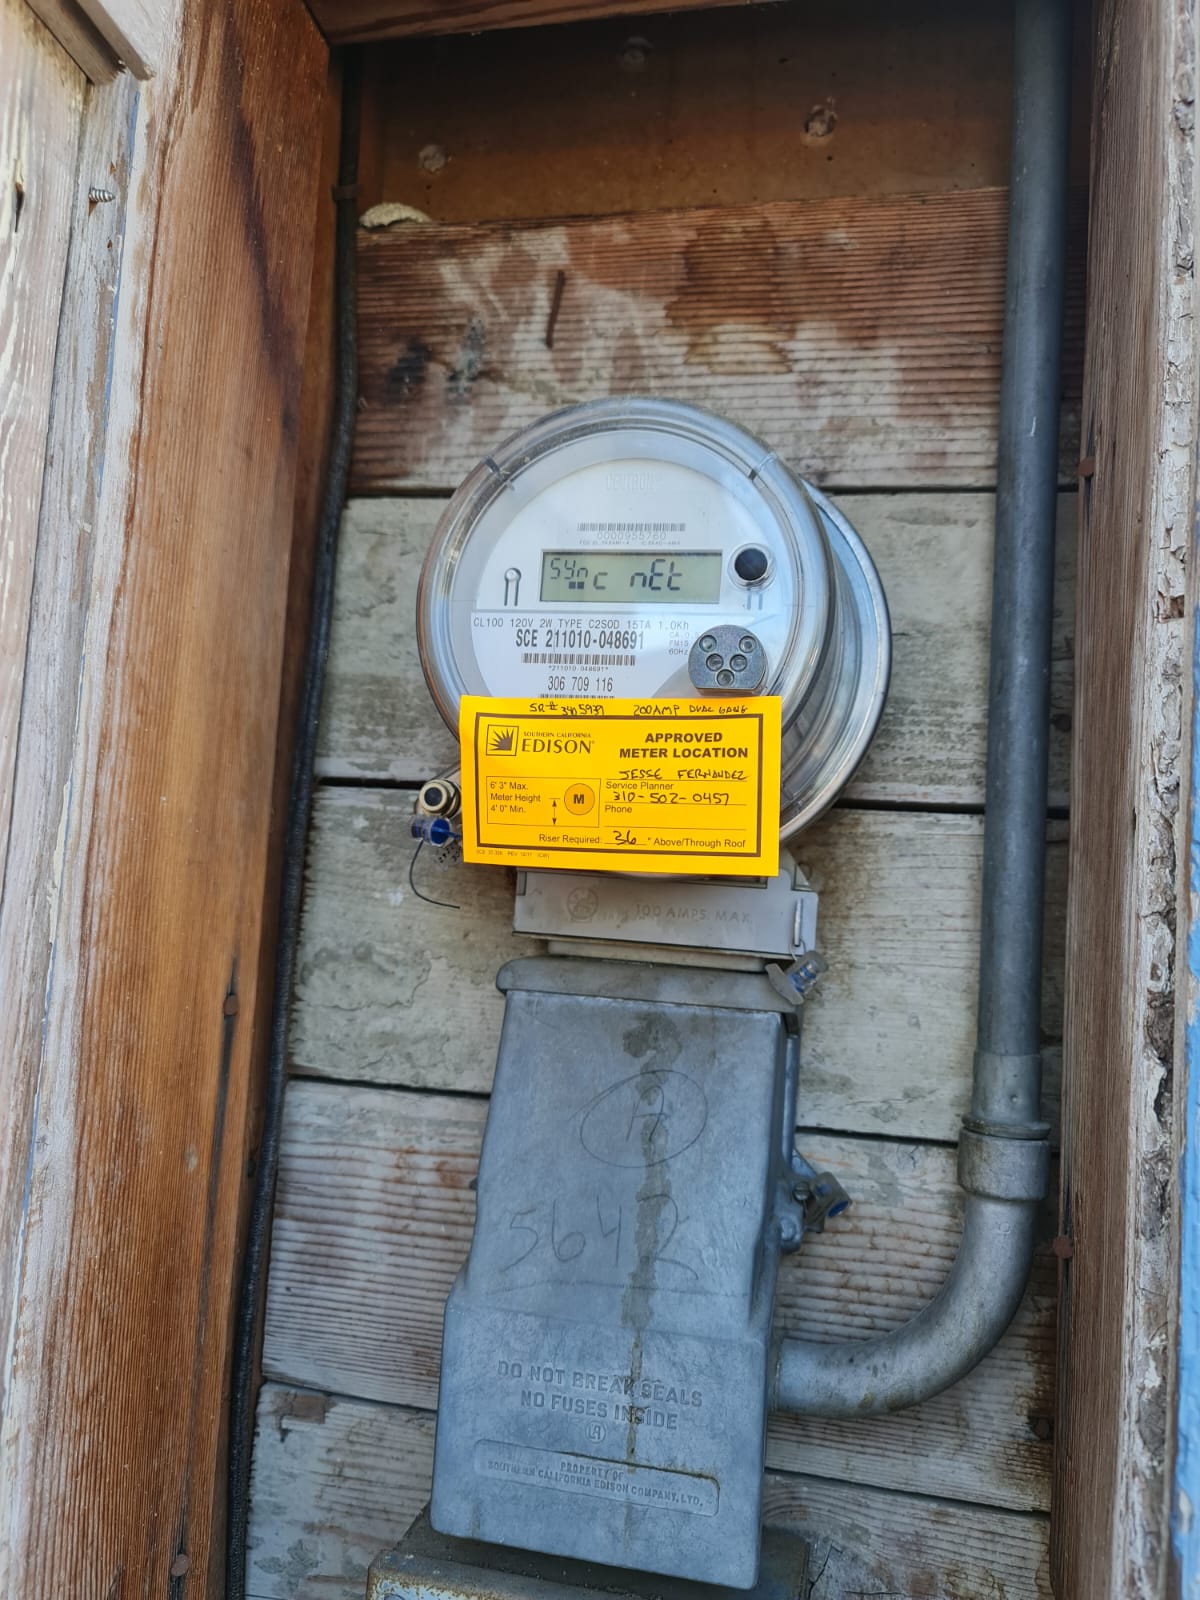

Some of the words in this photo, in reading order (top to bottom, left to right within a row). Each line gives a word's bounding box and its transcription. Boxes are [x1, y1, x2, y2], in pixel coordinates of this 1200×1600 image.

[473, 617, 504, 628] CL100
[511, 618, 534, 628] 120V
[539, 619, 553, 628] 2W
[558, 619, 583, 629] TYPE
[627, 620, 652, 630] 15TA
[515, 628, 539, 648] SCE
[545, 628, 644, 650] 211010-048691
[547, 675, 566, 692] 306
[571, 676, 590, 692] 709
[596, 677, 614, 693] 116
[644, 732, 723, 744] APPROVED
[521, 738, 592, 754] EDISON
[619, 747, 668, 759] METER
[673, 747, 749, 759] LOCATION
[619, 768, 663, 780] JESSE
[509, 782, 529, 791] Max.
[605, 781, 638, 790] Service
[640, 781, 674, 790] Planner
[490, 793, 512, 801] Meter
[514, 793, 541, 804] Height
[573, 793, 585, 805] M
[509, 805, 527, 813] Min.
[605, 804, 633, 814] Phone
[539, 833, 560, 843] Riser
[612, 829, 637, 846] 36
[653, 838, 722, 849] Above/Through
[724, 839, 746, 848] Roof
[635, 903, 661, 917] 100
[498, 1359, 522, 1378] DO
[529, 1365, 565, 1385] NOT
[572, 1371, 635, 1396] BREAK
[641, 1381, 703, 1407] SEALS
[520, 1389, 545, 1409] NO
[551, 1394, 608, 1418] FUSES
[614, 1403, 678, 1430] INSIDE
[560, 1461, 610, 1479] PROPERTY
[612, 1470, 624, 1481] OF
[487, 1460, 537, 1477] SOUTHERN
[538, 1467, 592, 1487] CALIFORNIA
[593, 1477, 630, 1495] EDISON
